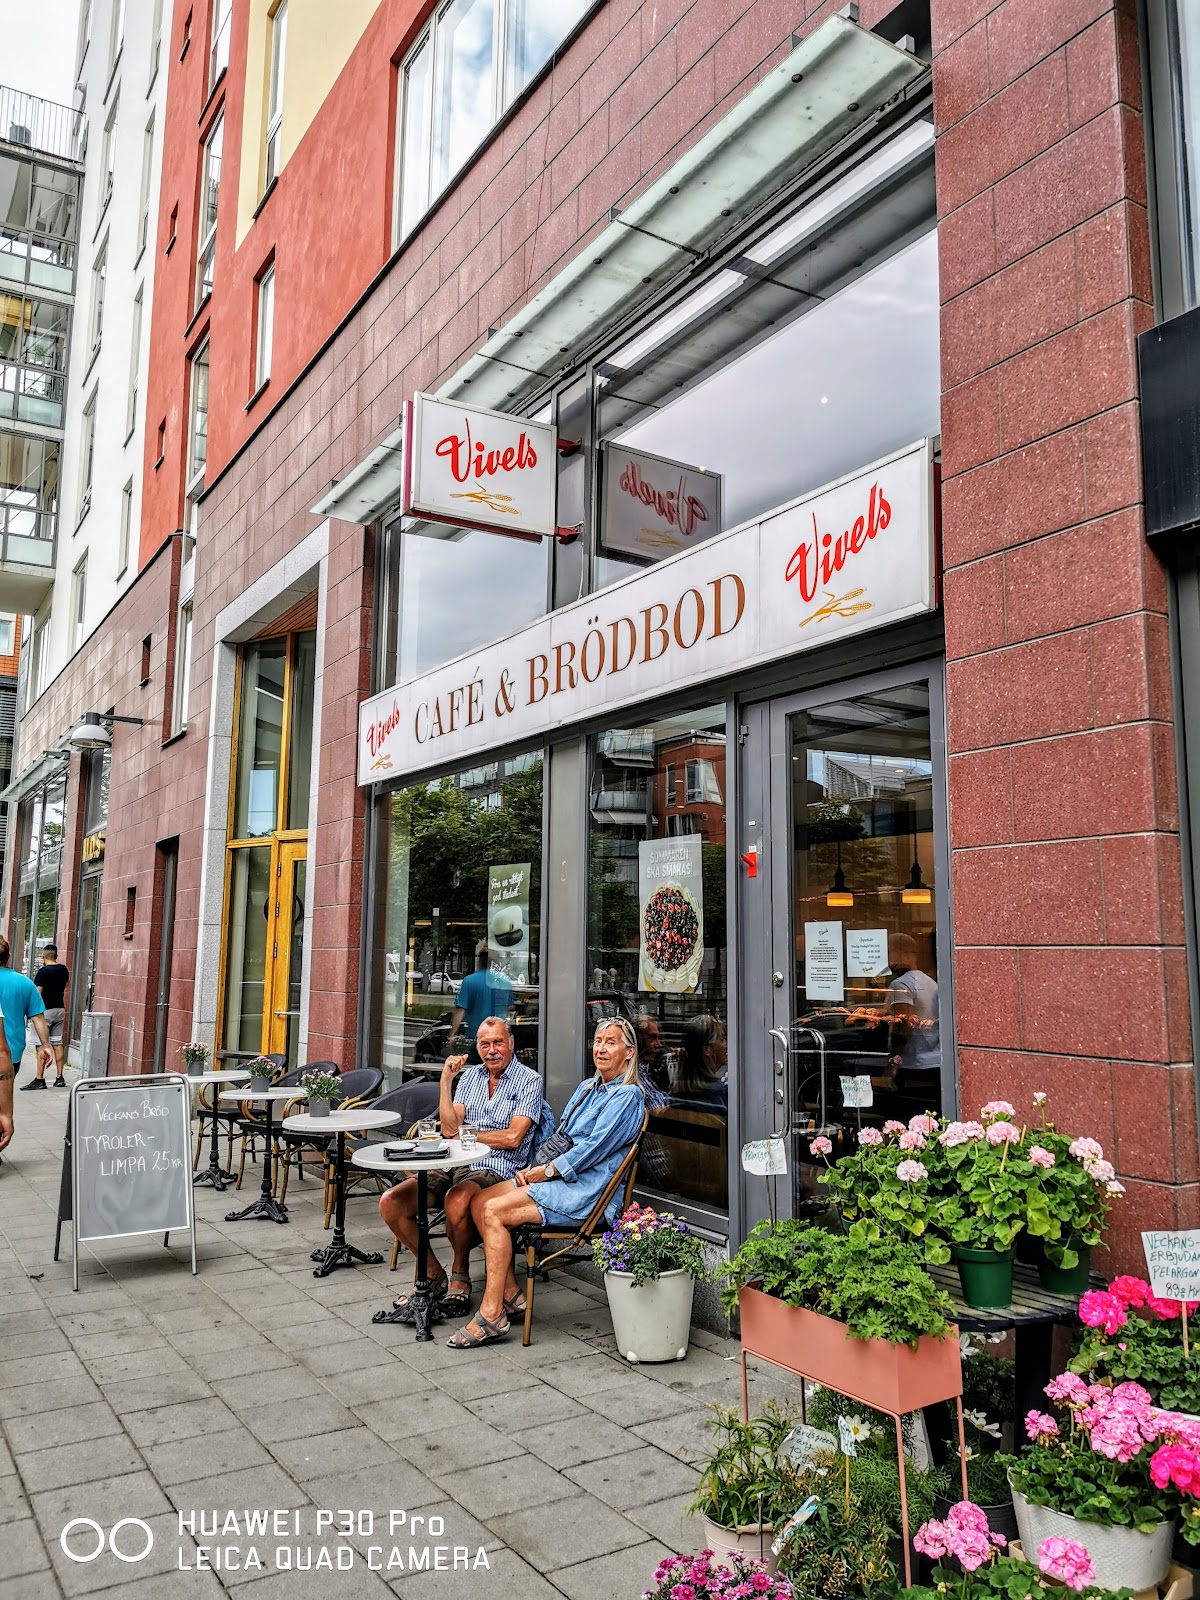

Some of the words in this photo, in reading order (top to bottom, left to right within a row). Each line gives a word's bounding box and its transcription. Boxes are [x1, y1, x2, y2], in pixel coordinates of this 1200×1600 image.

[435, 418, 538, 483] Vivels
[785, 480, 892, 603] Vivels
[414, 666, 485, 744] CAFÉ
[494, 668, 516, 718] &
[525, 573, 746, 706] BRÖDBOD
[366, 699, 400, 757] Vivels
[646, 865, 660, 879] SKA
[661, 862, 693, 878] SMAKAS!
[650, 847, 689, 864] SOMMAREN
[81, 1132, 155, 1154] TYROLER-
[101, 1156, 146, 1176] LIMPA
